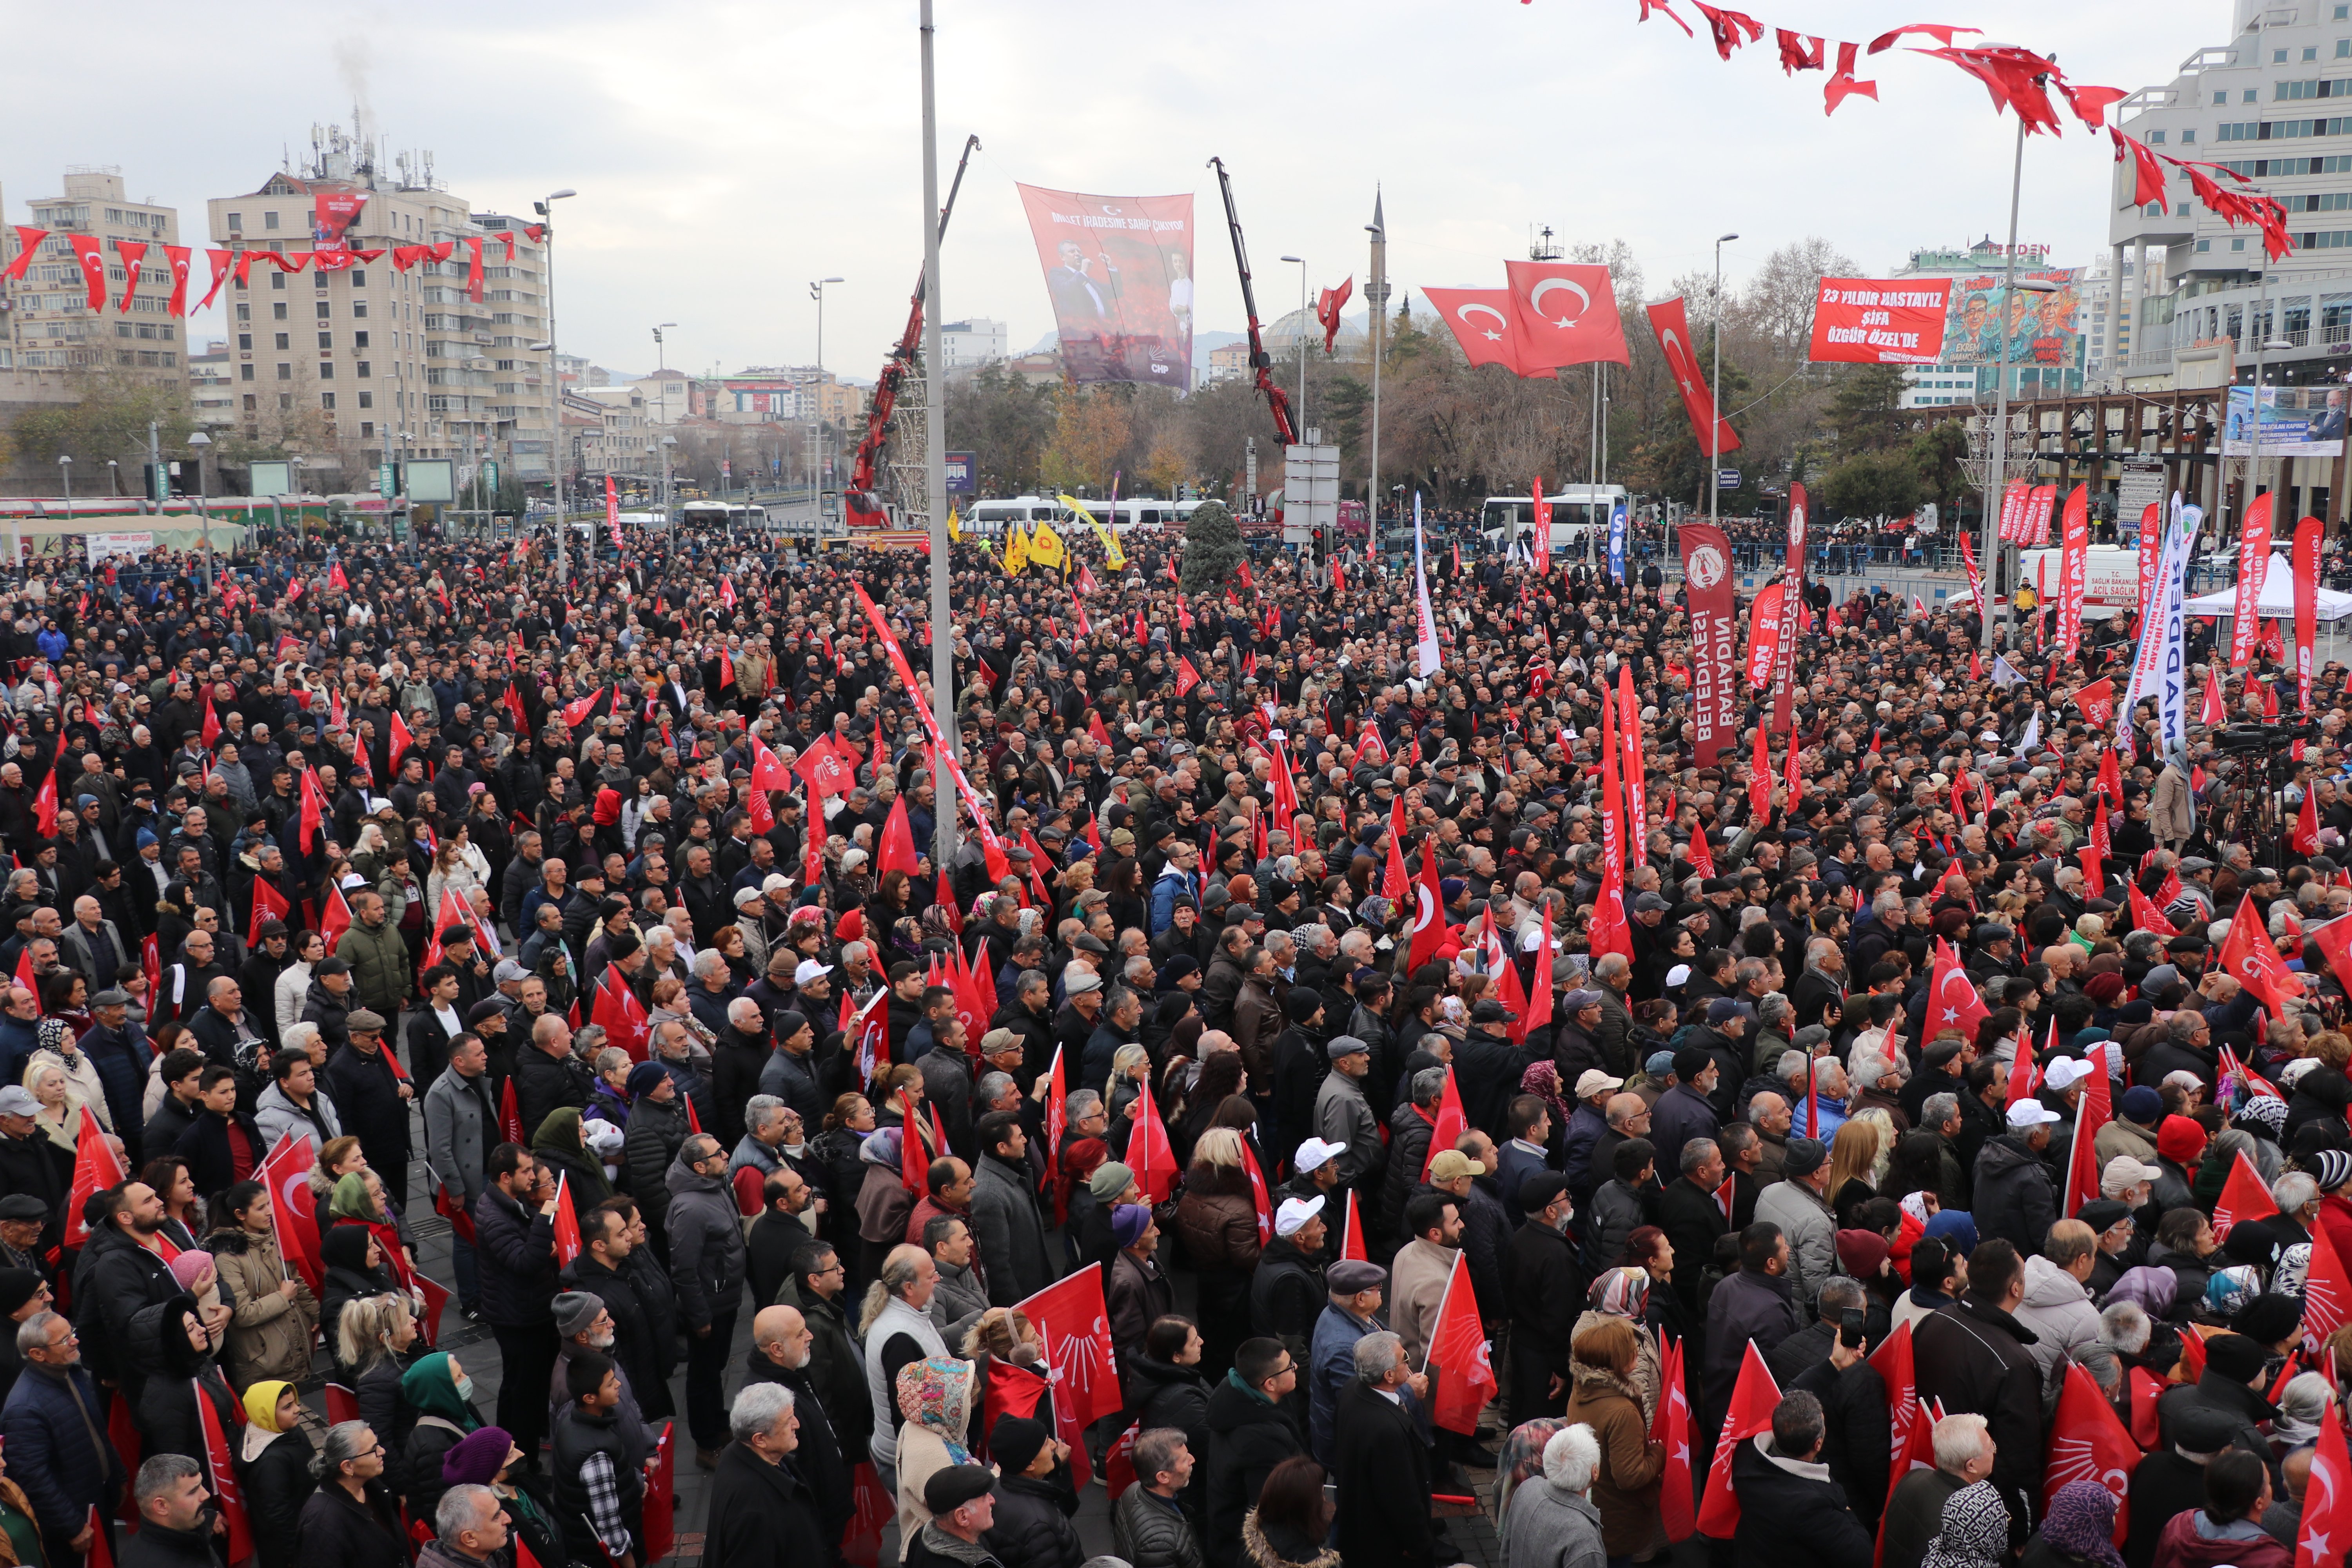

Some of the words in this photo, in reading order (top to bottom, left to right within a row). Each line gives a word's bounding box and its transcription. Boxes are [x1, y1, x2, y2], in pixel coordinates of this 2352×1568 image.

[1052, 212, 1081, 226] MİLLET
[1083, 215, 1127, 229] İRADESİNE
[1128, 218, 1151, 231] SAHİP
[1152, 220, 1184, 232] ÇIKIYOR
[1965, 276, 1996, 292] DOĞRU
[1822, 289, 1839, 303] 23
[1841, 291, 1880, 306] YILDIR
[1880, 292, 1942, 307] HASTAYIZ
[1861, 310, 1889, 327] ŞİFA
[1827, 326, 1867, 343] ÖZGÜR
[1867, 329, 1919, 348] ÖZEL'DE
[1956, 342, 1980, 352] EKREM
[2033, 336, 2063, 349] MANSUR
[1950, 351, 1987, 362] İMAMOĞLU
[1151, 363, 1169, 374] CHP
[2069, 526, 2085, 541] CHP
[2143, 534, 2155, 544] CHP
[2247, 526, 2263, 539] CHP
[1611, 514, 1624, 577] SOL
[2093, 585, 2108, 595] ACİL
[2111, 586, 2136, 595] SAĞLIK
[2235, 542, 2255, 661] SARIOGLAN
[2148, 627, 2163, 671] KAYSERİ
[2088, 704, 2103, 724] CHP
